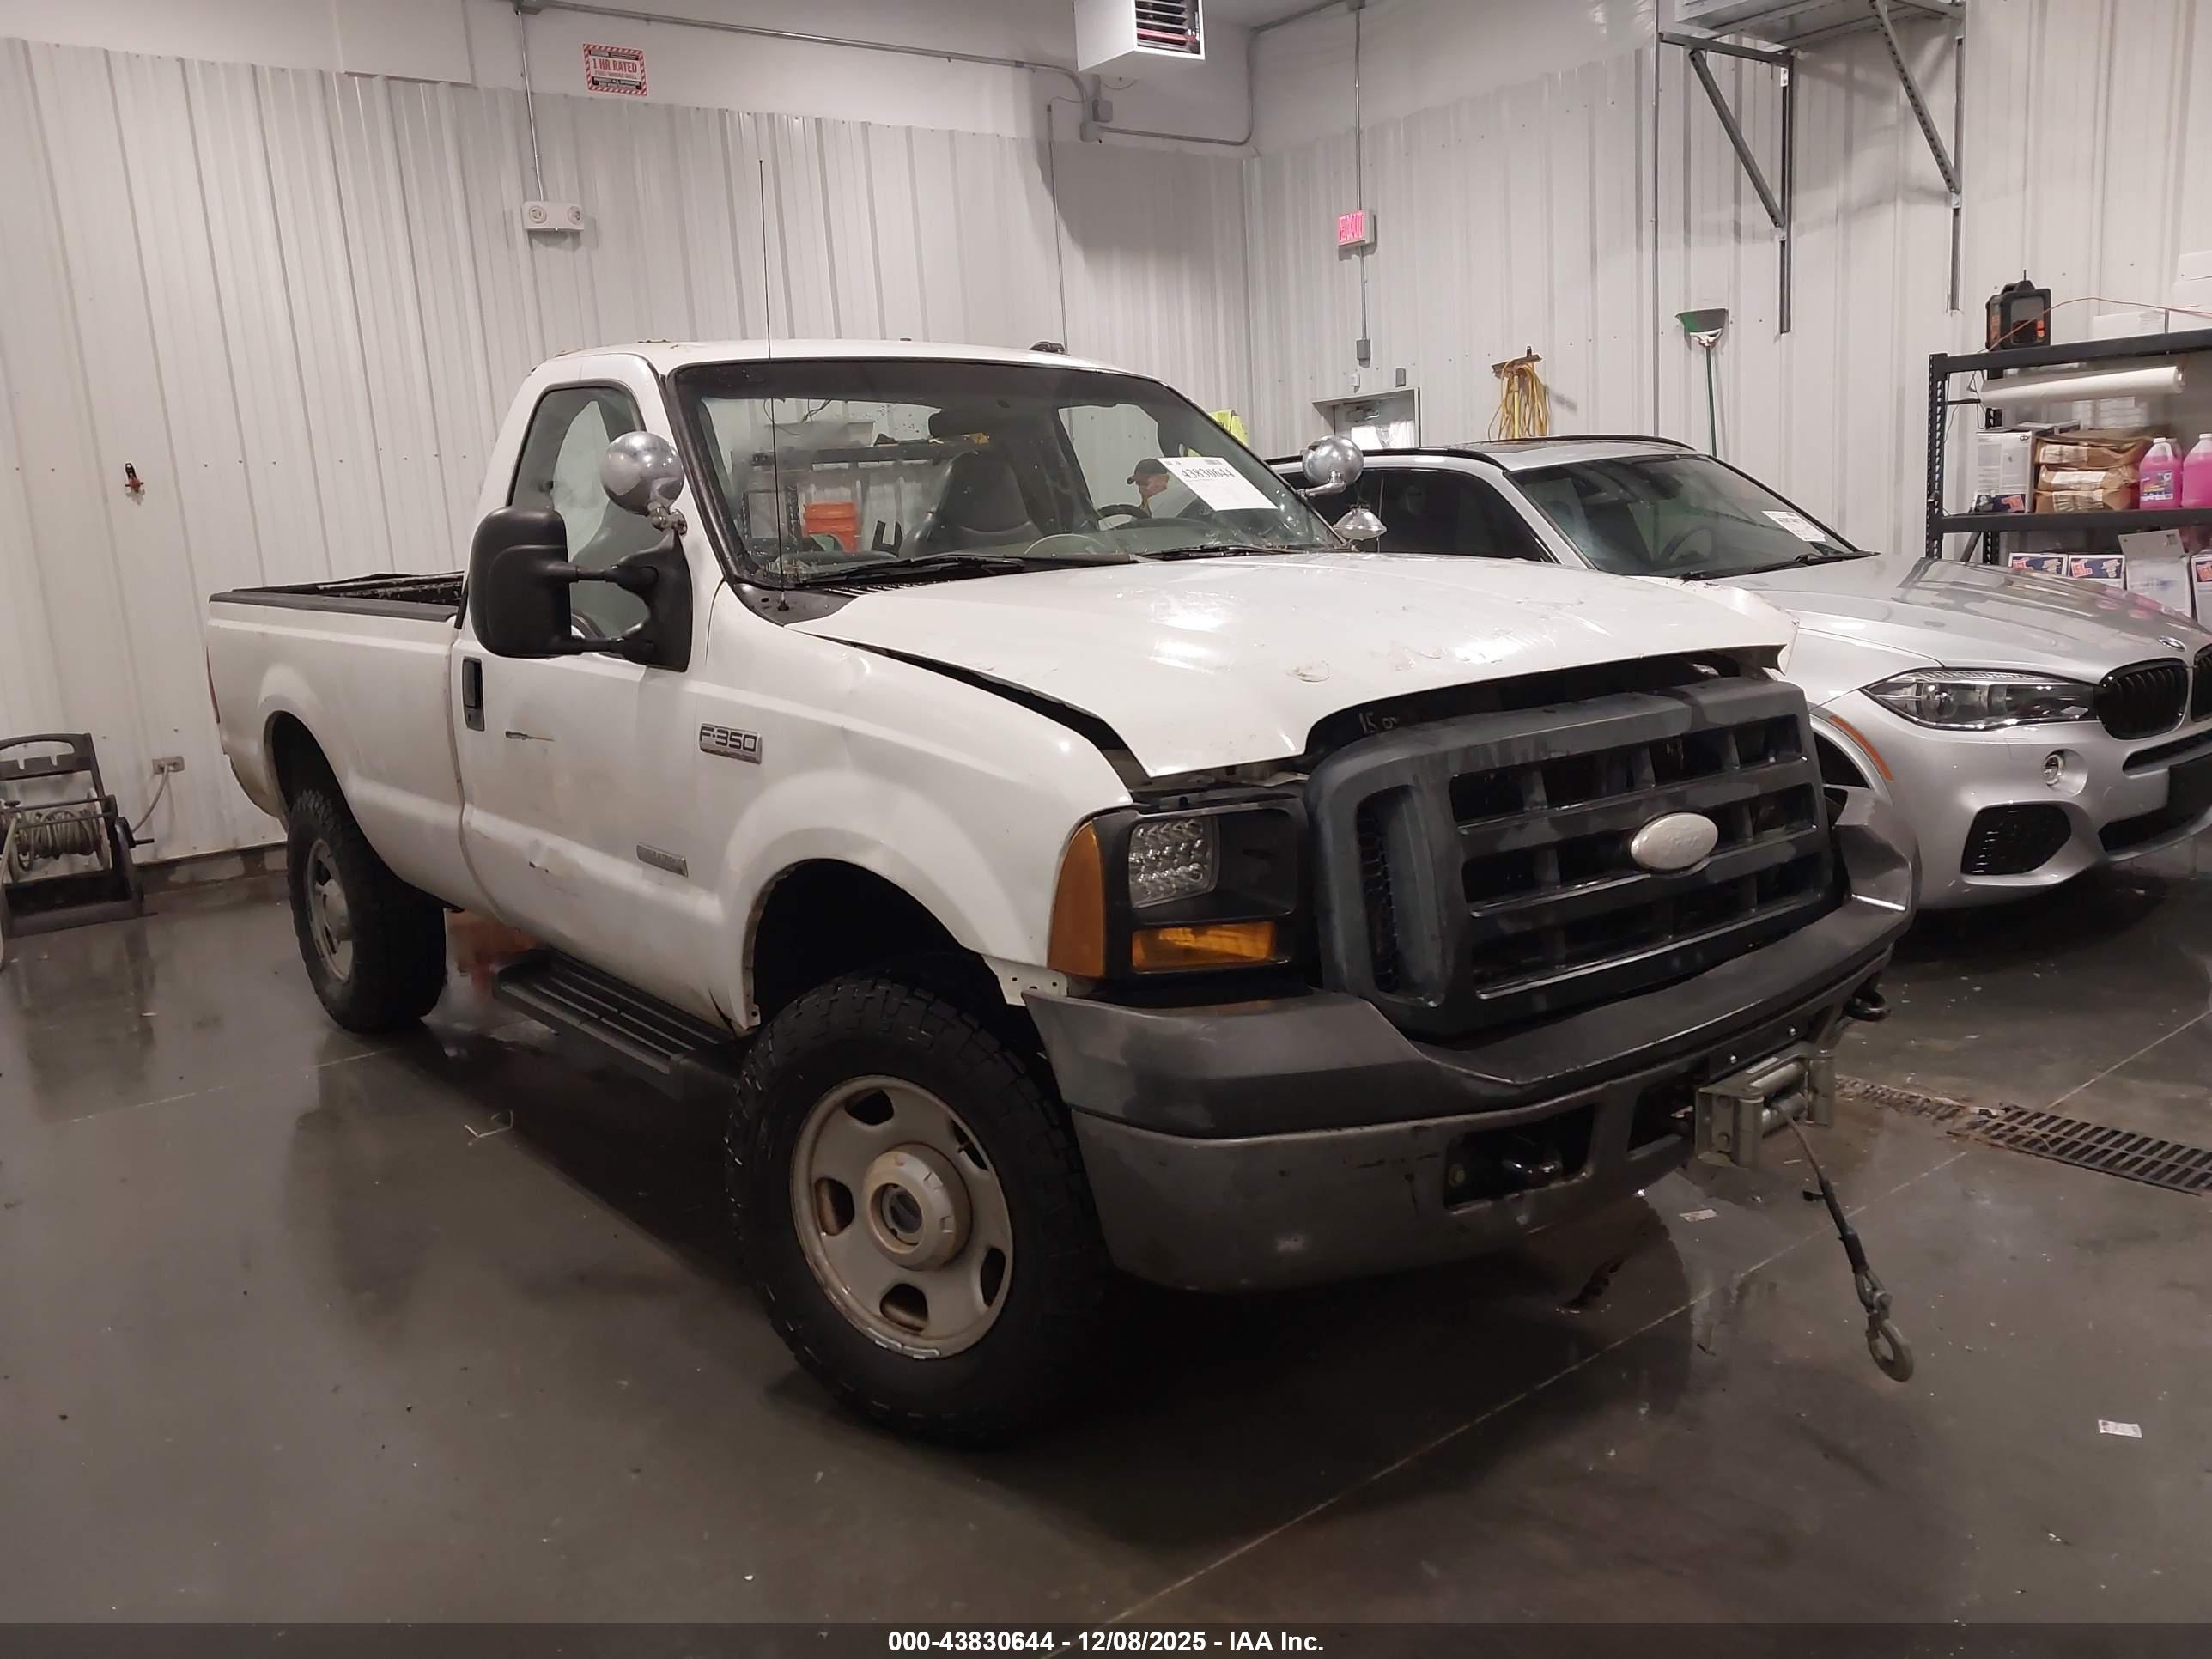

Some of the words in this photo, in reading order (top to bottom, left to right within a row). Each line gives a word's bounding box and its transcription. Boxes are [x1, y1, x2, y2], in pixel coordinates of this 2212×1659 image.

[592, 58, 598, 70] 1
[599, 58, 611, 70] HR
[613, 60, 637, 73] RATED
